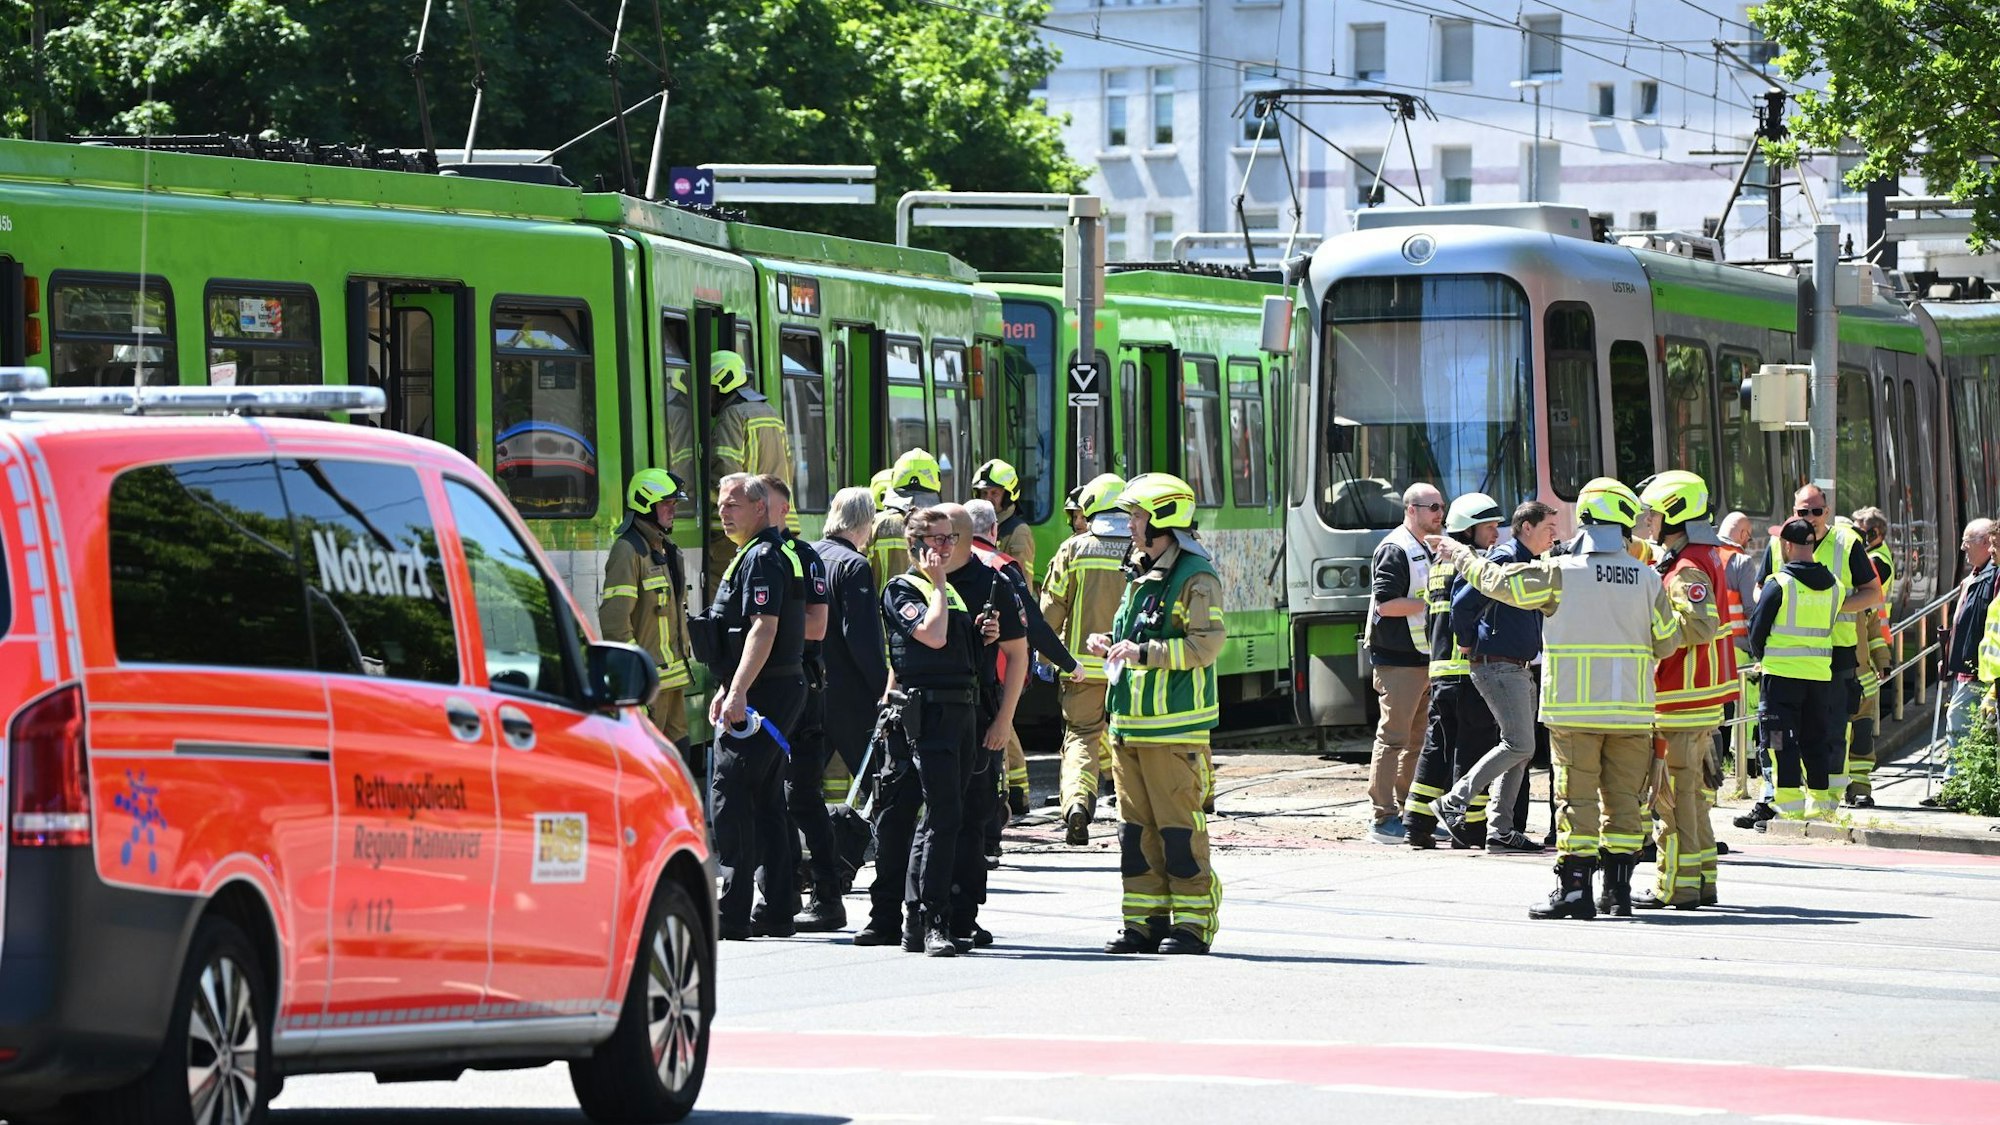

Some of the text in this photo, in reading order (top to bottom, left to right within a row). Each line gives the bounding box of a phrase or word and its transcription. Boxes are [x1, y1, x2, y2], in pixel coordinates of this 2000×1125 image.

[0, 214, 13, 231] 5b
[1553, 411, 1569, 422] 13
[312, 530, 432, 600] Notarzt
[1596, 564, 1640, 585] B-DIENST
[354, 774, 468, 820] Rettungsdienst
[353, 824, 482, 869] Region Hannover
[366, 898, 394, 932] 112
